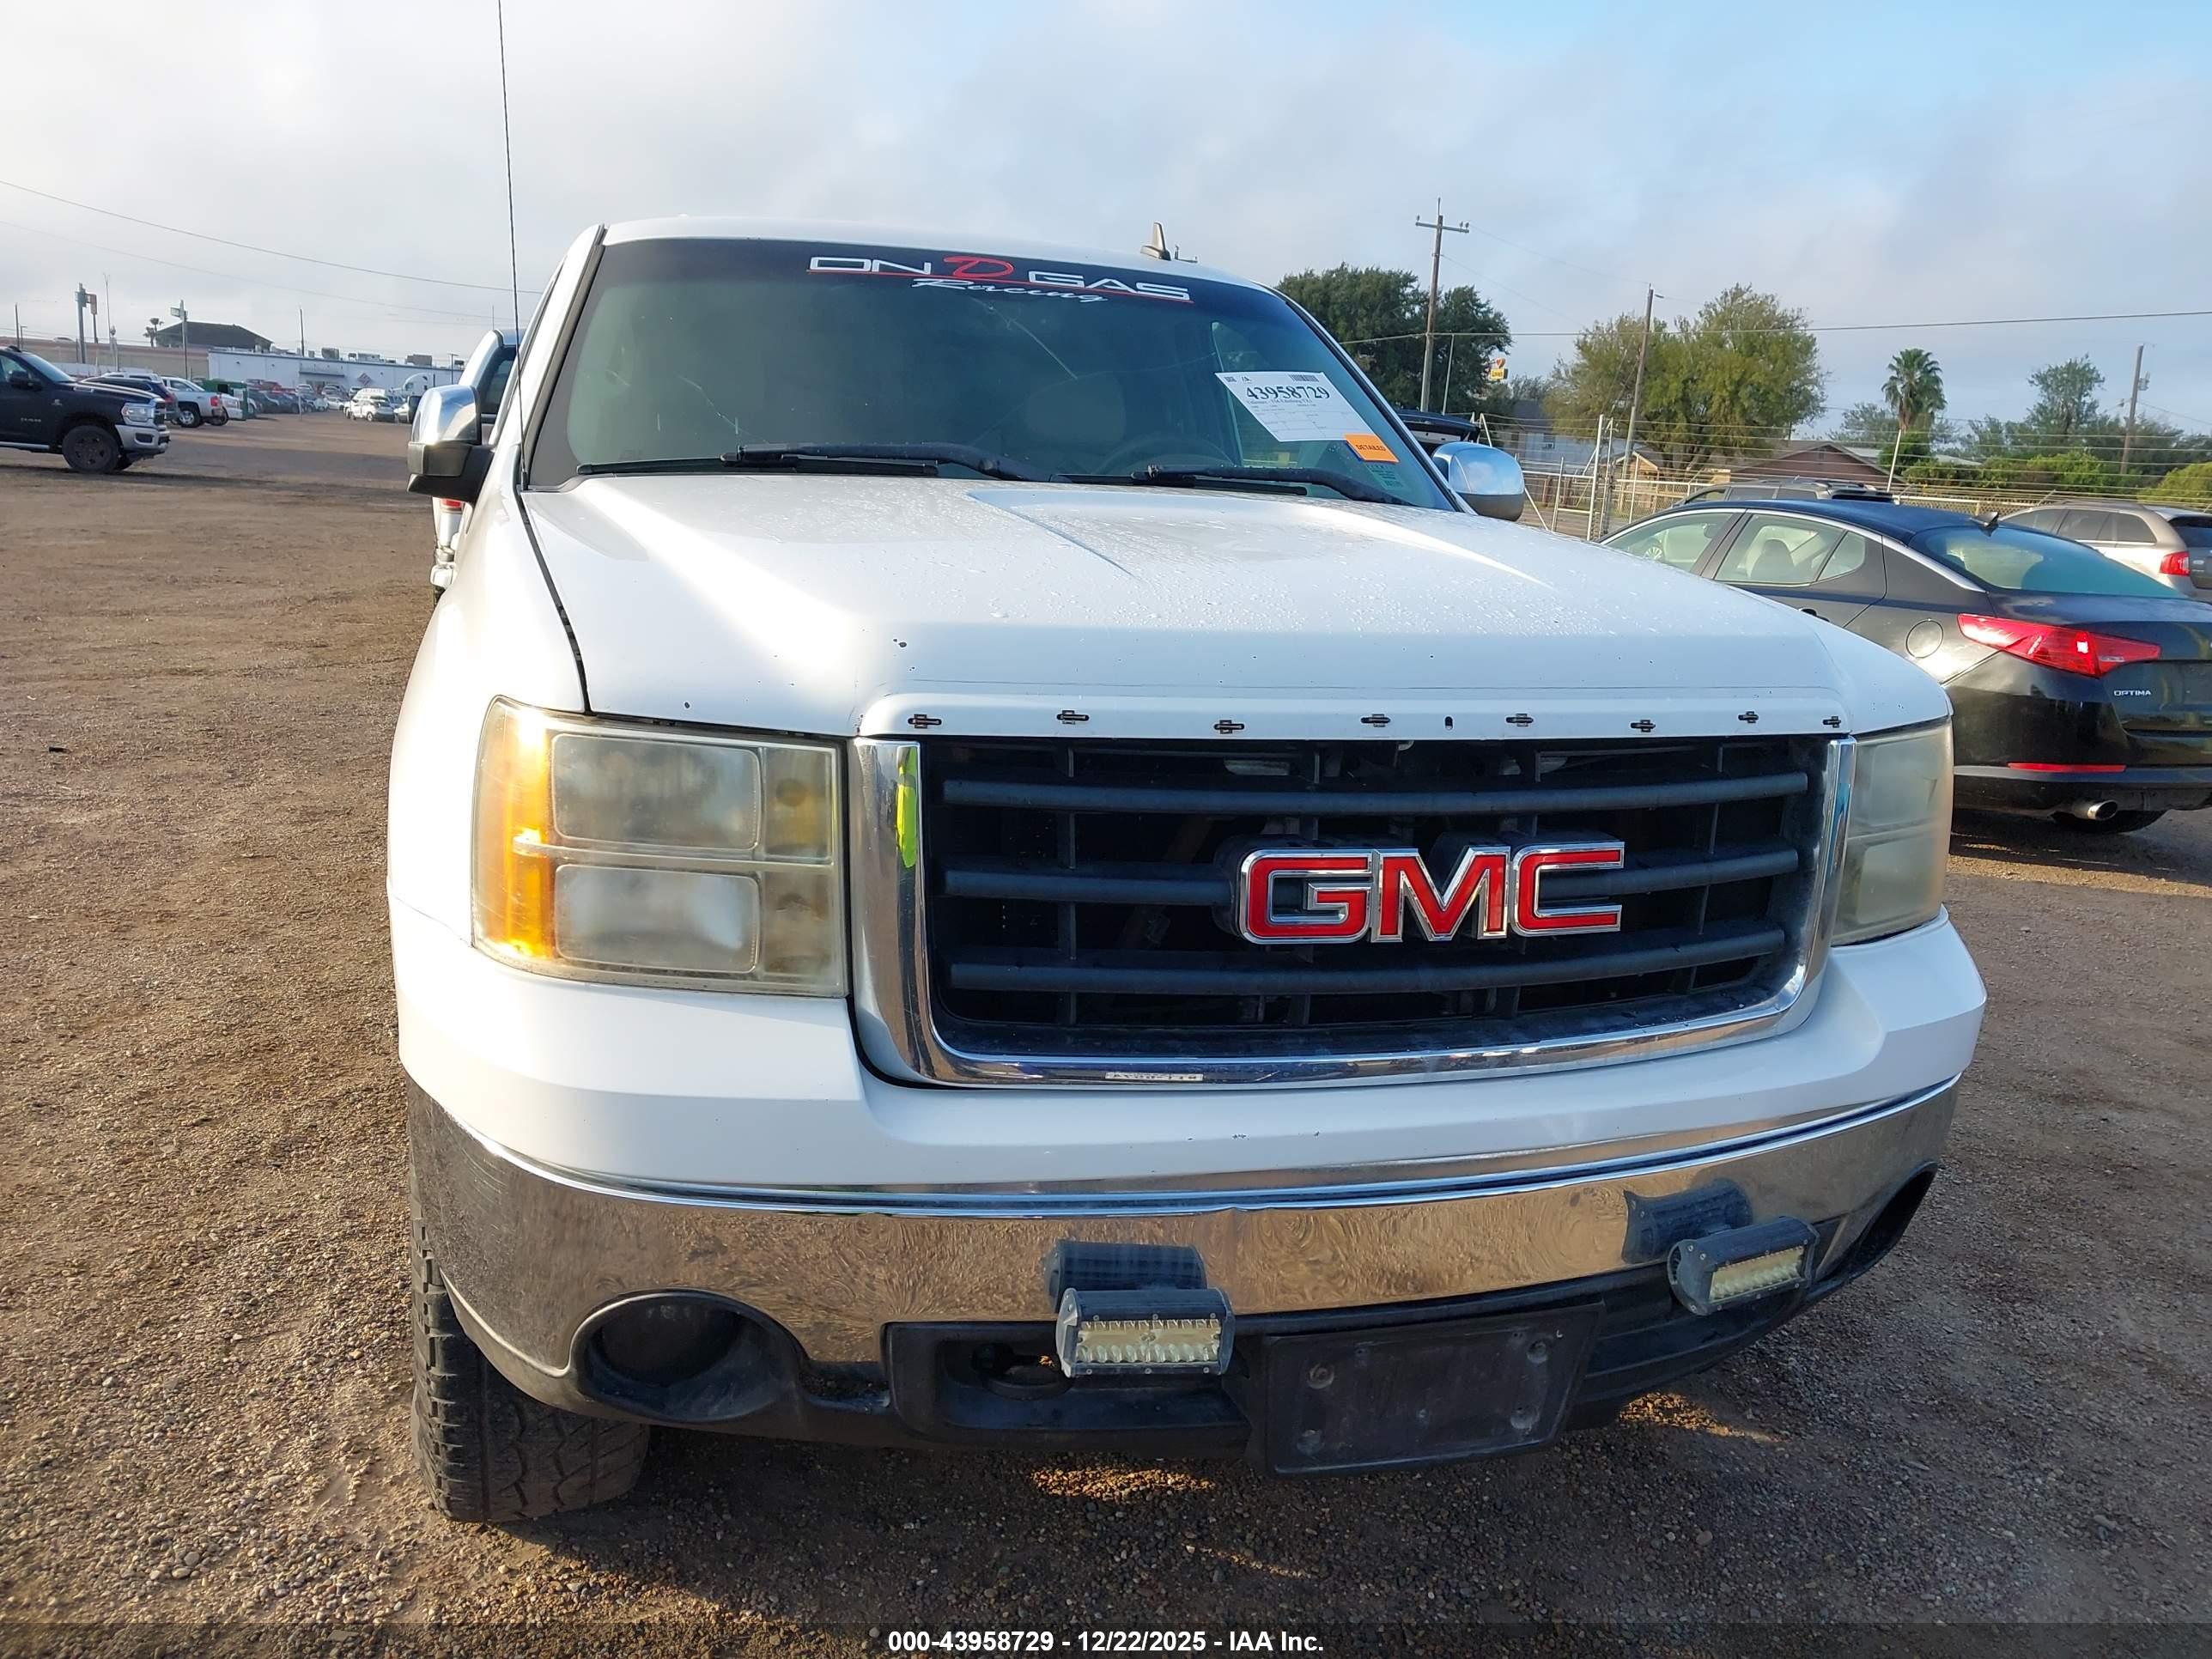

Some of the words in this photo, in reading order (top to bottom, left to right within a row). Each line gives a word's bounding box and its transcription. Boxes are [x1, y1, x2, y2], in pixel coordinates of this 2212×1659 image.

[810, 257, 932, 276] ON
[943, 254, 1014, 279] D
[1029, 270, 1190, 301] GAS
[911, 278, 1109, 303] Racing
[1246, 386, 1330, 399] 43958729
[1239, 841, 1626, 945] GMC
